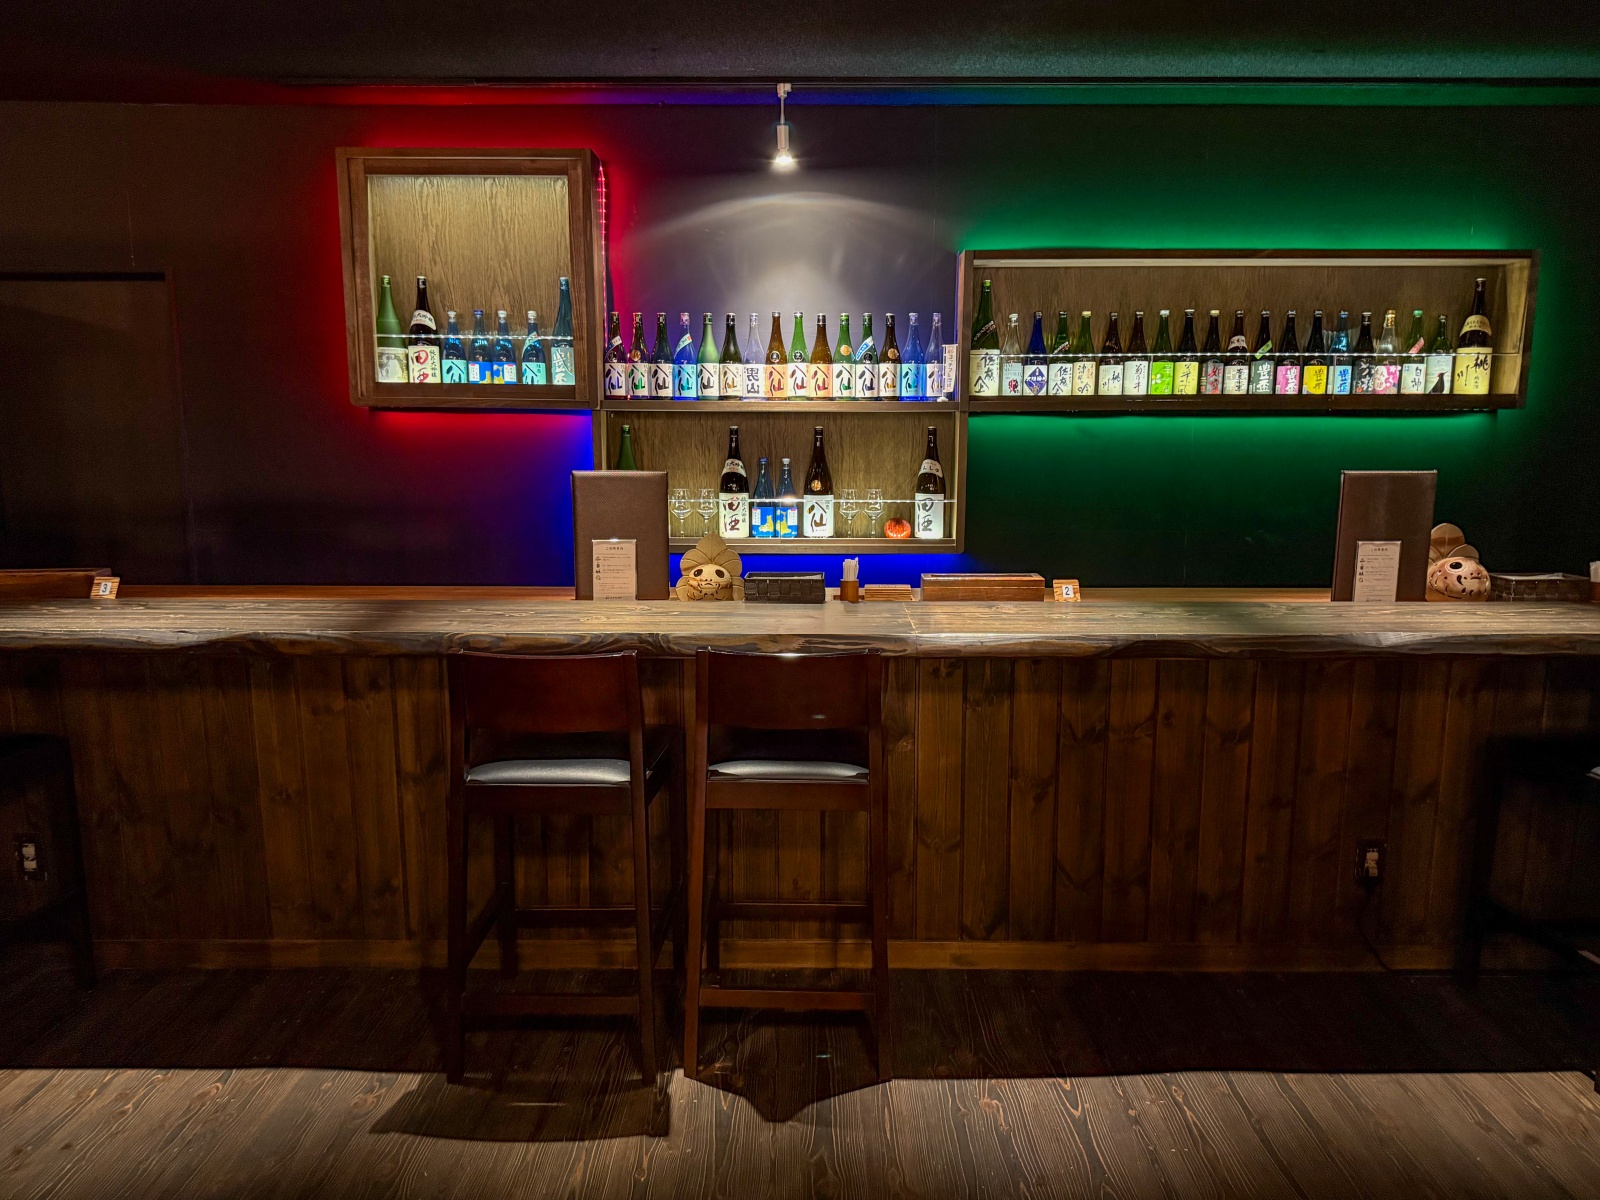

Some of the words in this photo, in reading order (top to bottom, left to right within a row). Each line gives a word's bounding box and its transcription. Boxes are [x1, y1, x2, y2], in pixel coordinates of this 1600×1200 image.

[606, 364, 622, 395] 八仙
[629, 364, 645, 395] 八仙
[652, 365, 669, 395] 八仙
[698, 364, 714, 395] 八仙
[724, 366, 738, 393] 八仙
[769, 366, 785, 396] 八仙
[790, 365, 807, 395] 八仙
[811, 366, 829, 396] 八仙
[836, 365, 853, 395] 八仙
[858, 366, 876, 396] 八仙
[1457, 352, 1490, 387] 桃川
[723, 496, 740, 532] 田酒
[807, 501, 827, 532] 八仙
[915, 497, 933, 532] 田酒
[101, 583, 108, 593] 3
[1064, 586, 1071, 596] 2
